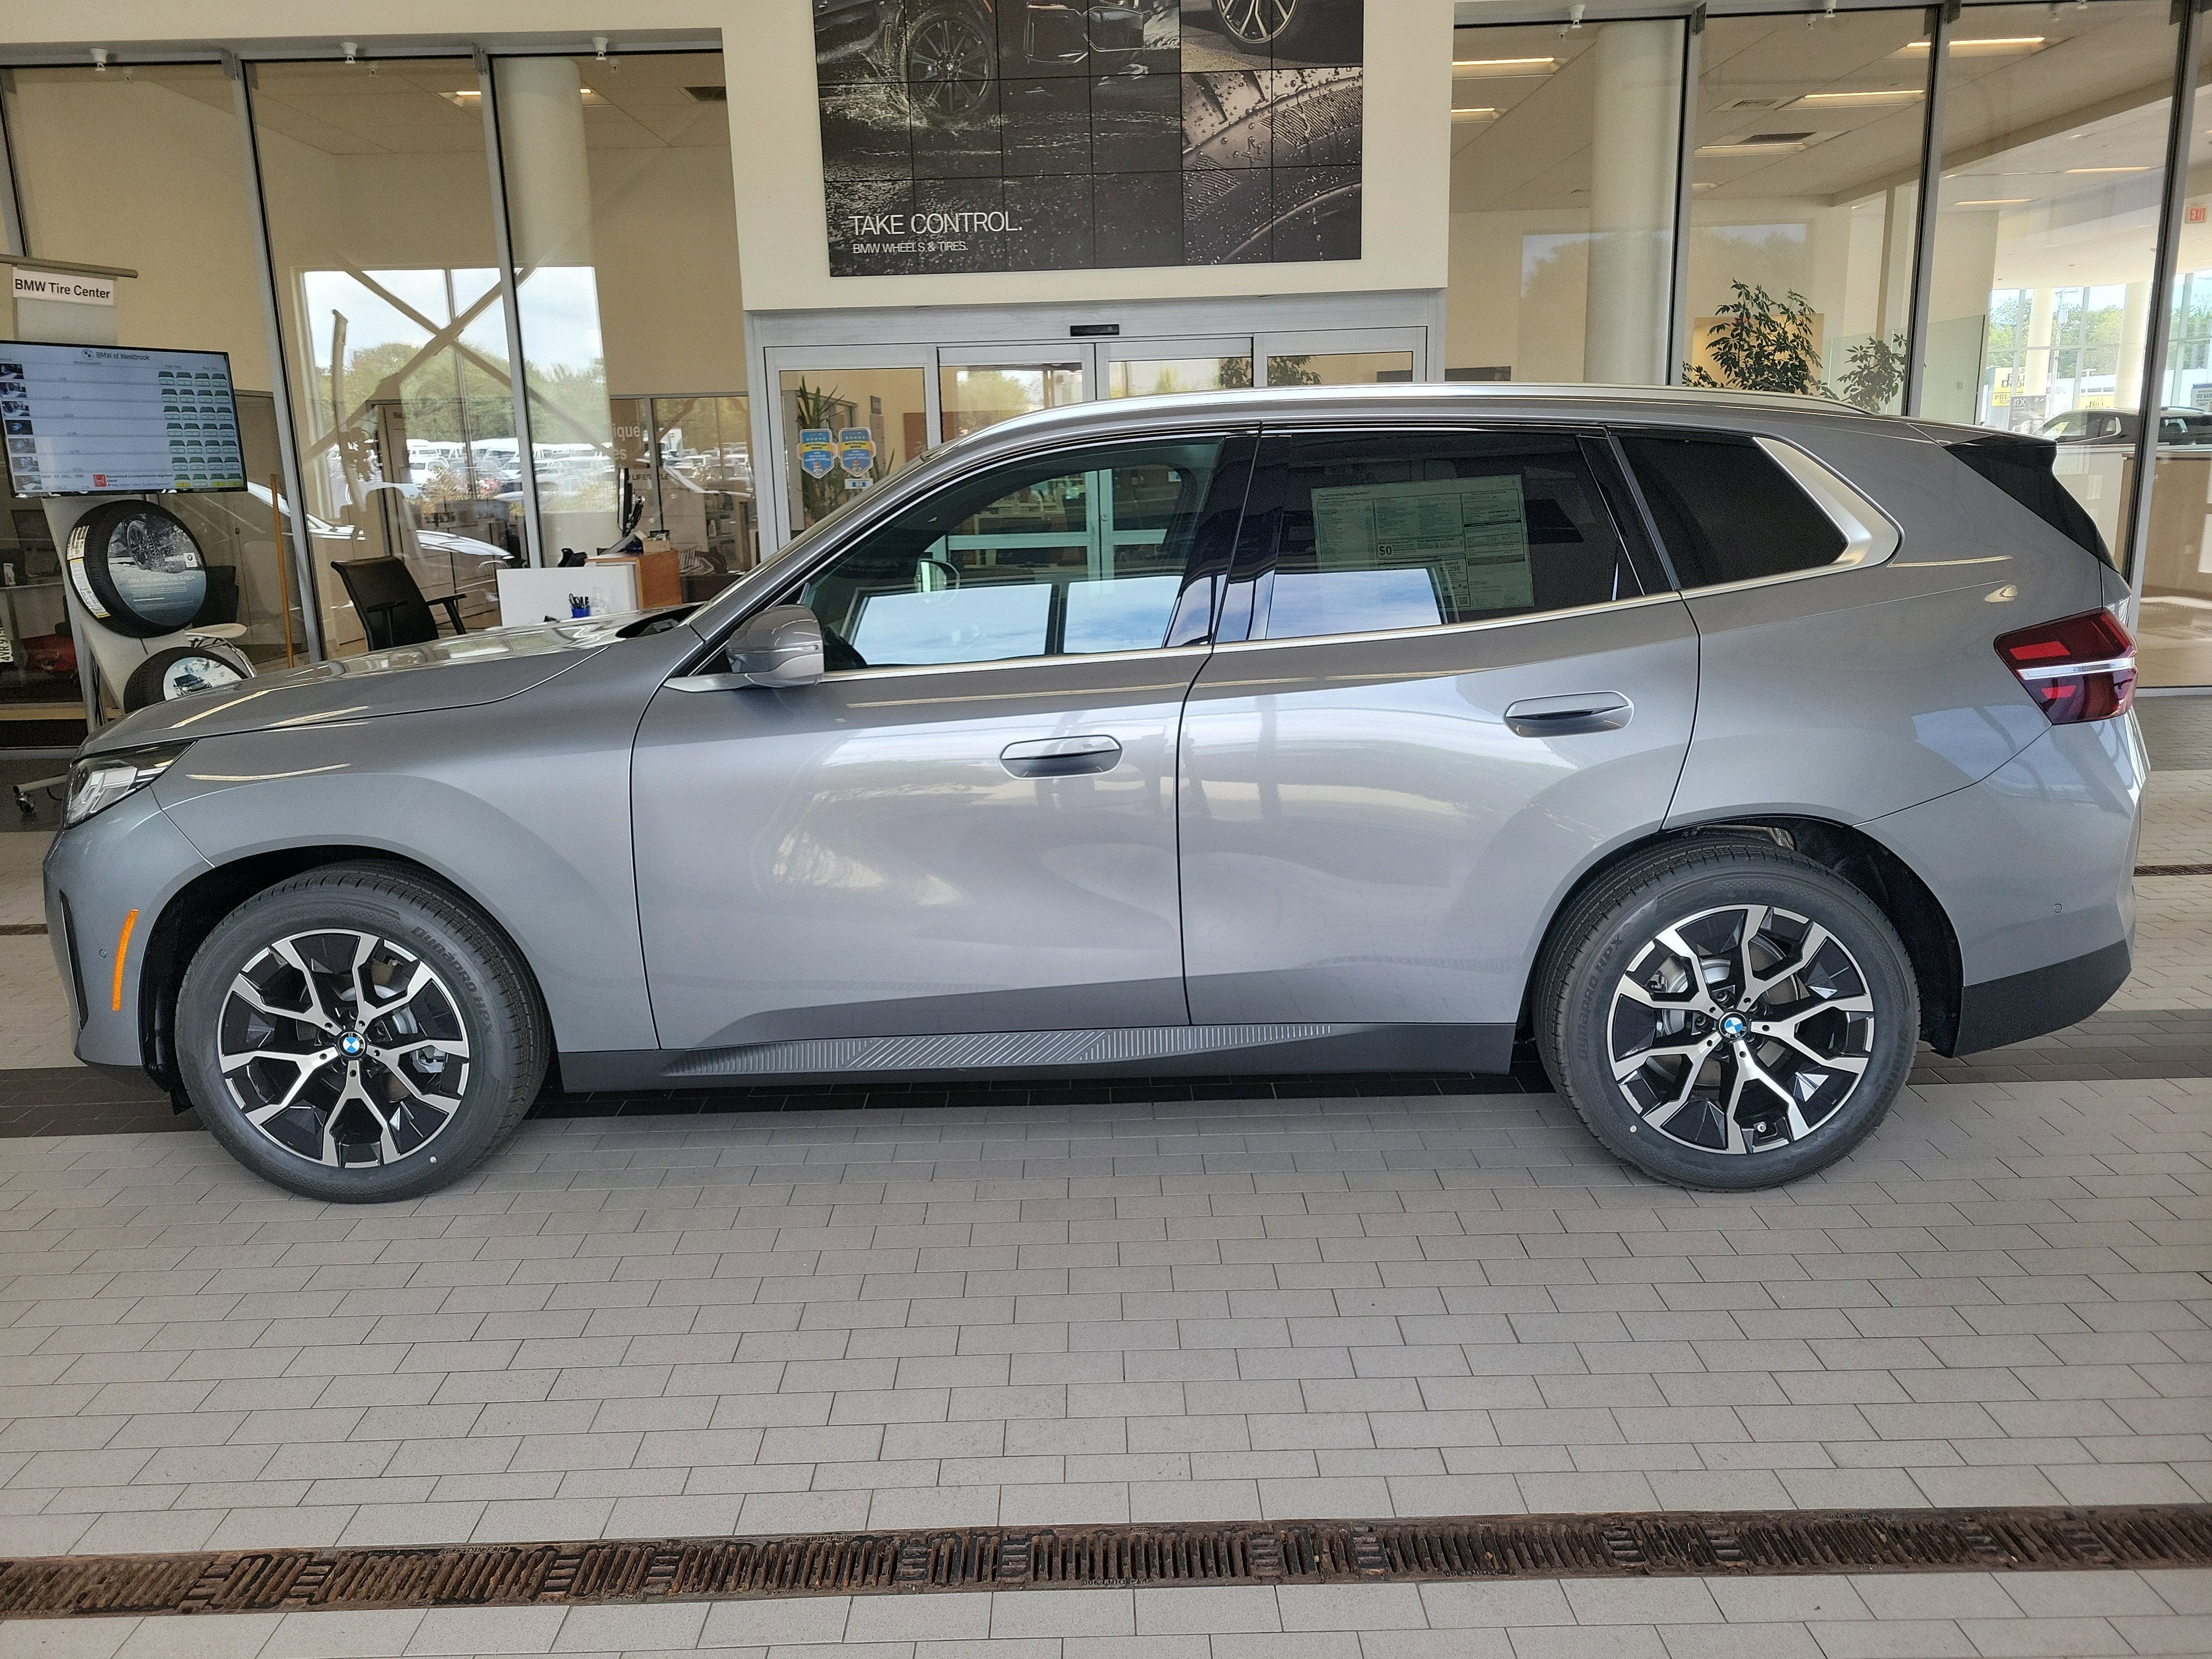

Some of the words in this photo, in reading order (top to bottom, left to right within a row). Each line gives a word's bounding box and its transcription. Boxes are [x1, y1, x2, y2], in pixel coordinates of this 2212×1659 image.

[2190, 208, 2206, 221] EXIT
[848, 214, 905, 236] TAKE
[911, 211, 1023, 235] CONTROL.
[853, 243, 879, 254] BMW
[882, 242, 926, 253] WHEELS
[927, 242, 936, 252] &
[939, 241, 968, 252] TIRES.
[15, 278, 46, 292] BMW
[48, 282, 71, 295] Tire
[74, 285, 111, 298] Center
[1379, 545, 1392, 556] $0
